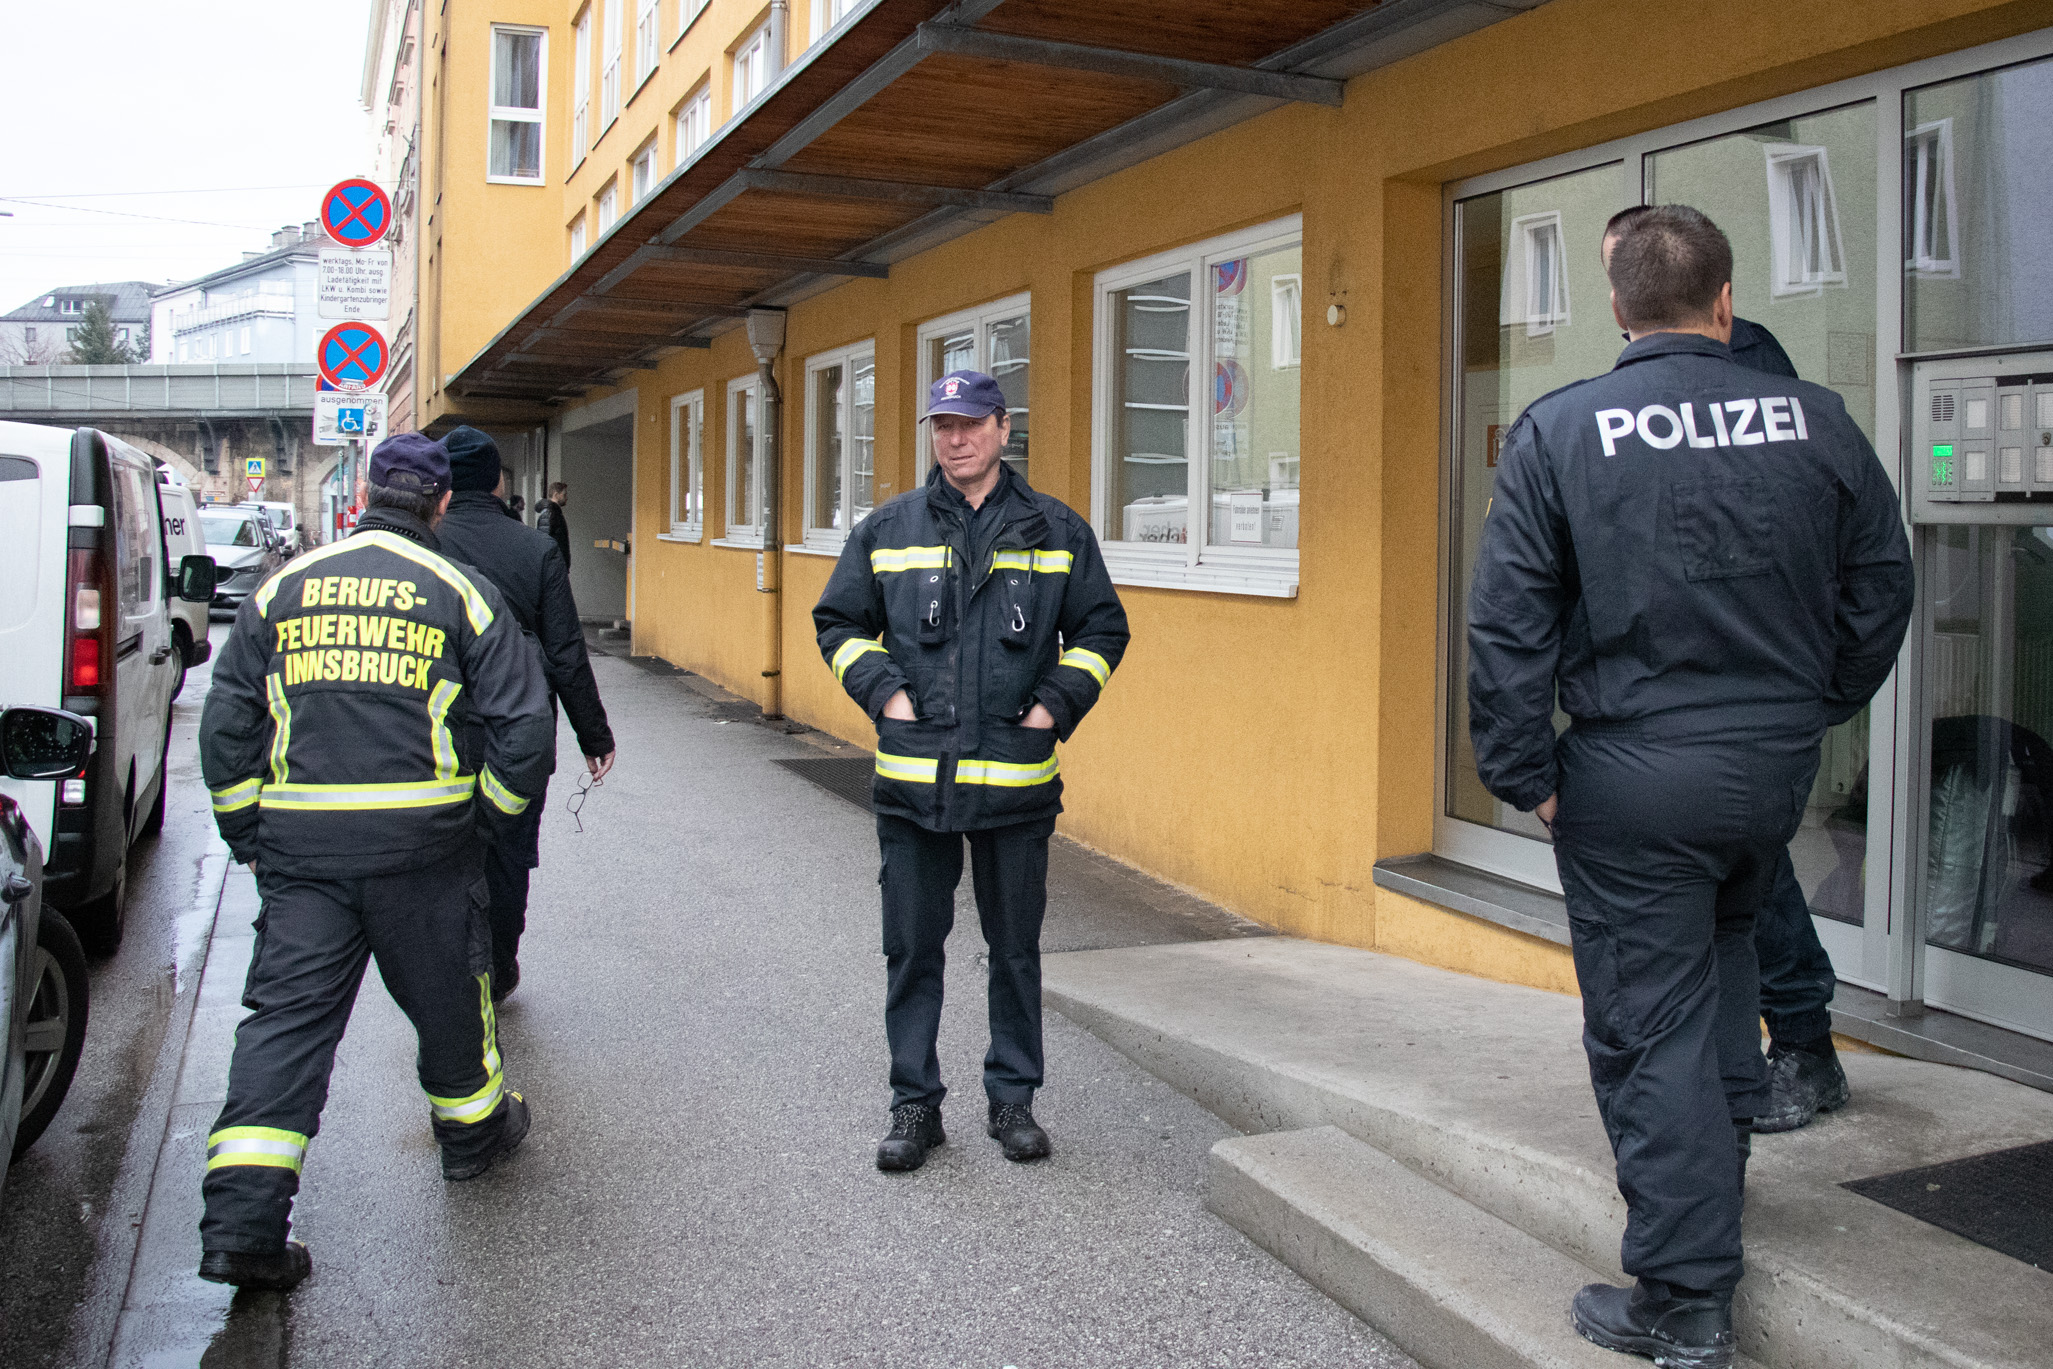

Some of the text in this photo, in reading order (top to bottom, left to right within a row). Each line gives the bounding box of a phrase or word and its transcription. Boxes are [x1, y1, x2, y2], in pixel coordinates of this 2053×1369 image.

[322, 266, 353, 274] 7.00-18.00
[327, 276, 369, 285] Ladetätigkeit
[321, 295, 388, 305] Kindergartenzubringer
[345, 305, 360, 313] Ende
[321, 396, 383, 405] ausgenommen
[1595, 397, 1808, 457] POLIZEI
[302, 576, 427, 611] BERUFS-
[276, 614, 446, 658] FEUERWEHR
[285, 649, 433, 690] INNSBRUCK
